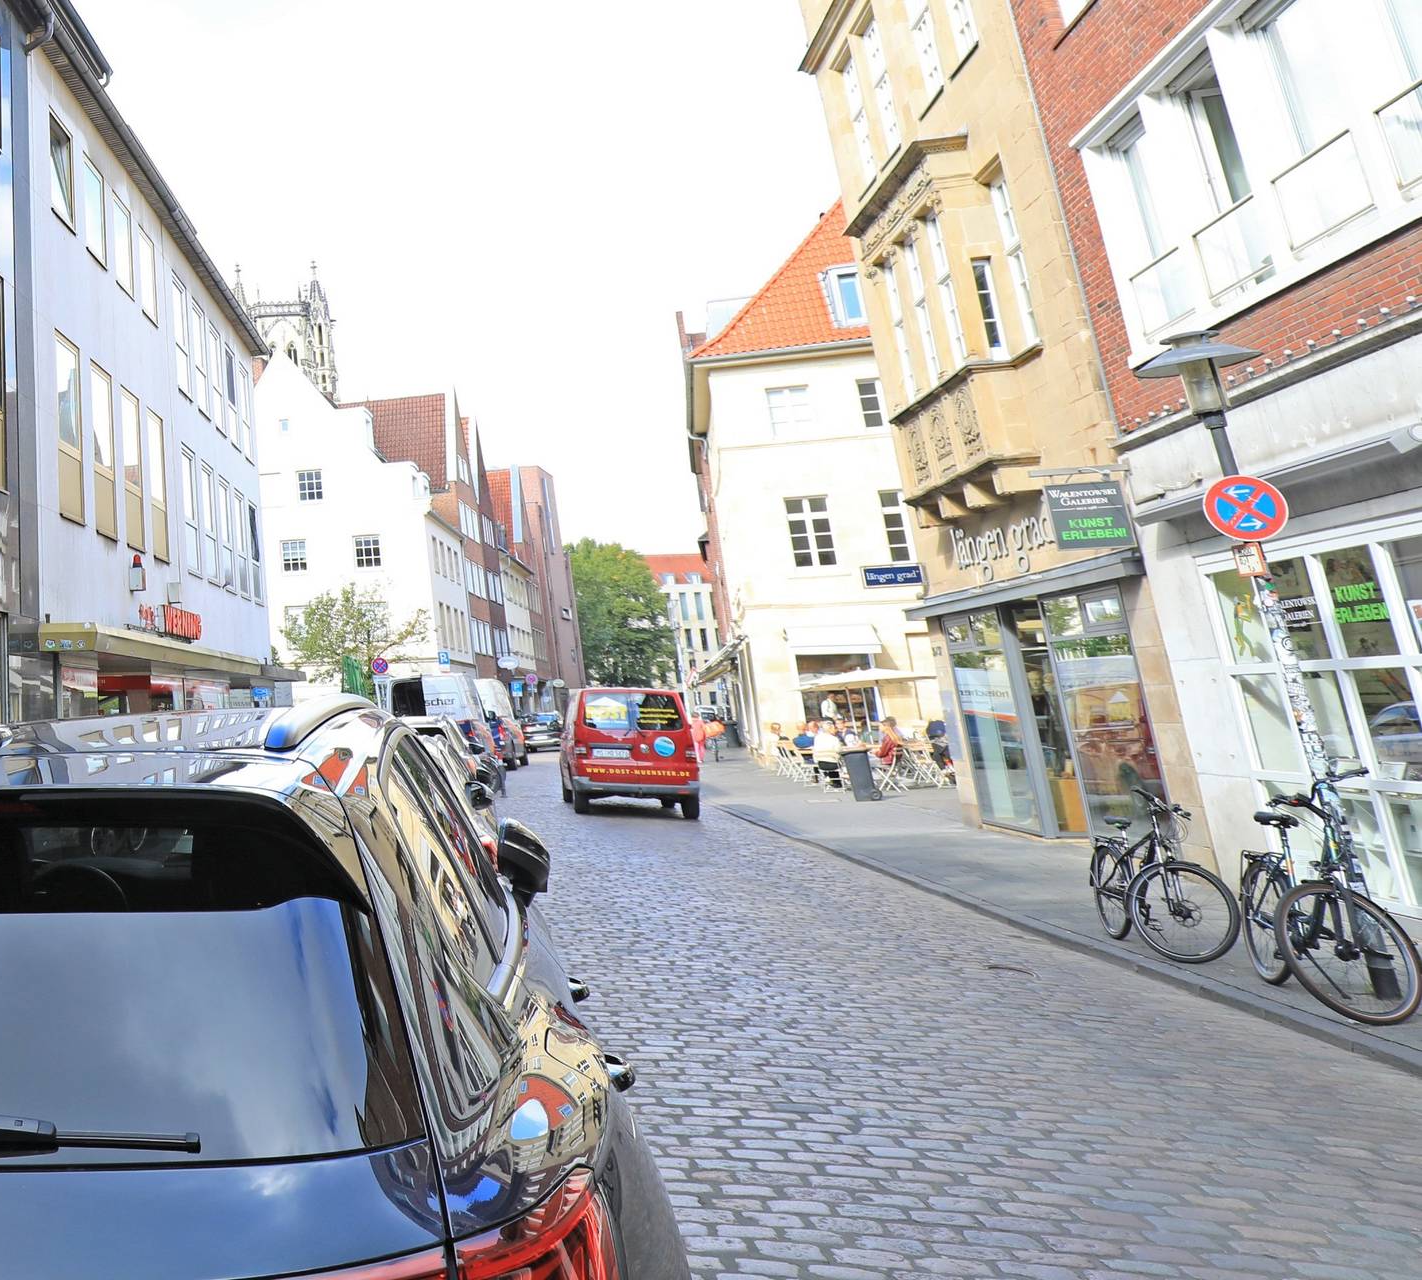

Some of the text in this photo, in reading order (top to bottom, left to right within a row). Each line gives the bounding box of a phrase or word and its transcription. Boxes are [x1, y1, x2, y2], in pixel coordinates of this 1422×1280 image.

[1060, 497, 1108, 506] GALERIEN
[1068, 517, 1113, 529] KUNST
[1061, 527, 1127, 541] ERLEBEN!
[1334, 582, 1377, 603] KUNST
[1334, 601, 1389, 625] ERLEBEN
